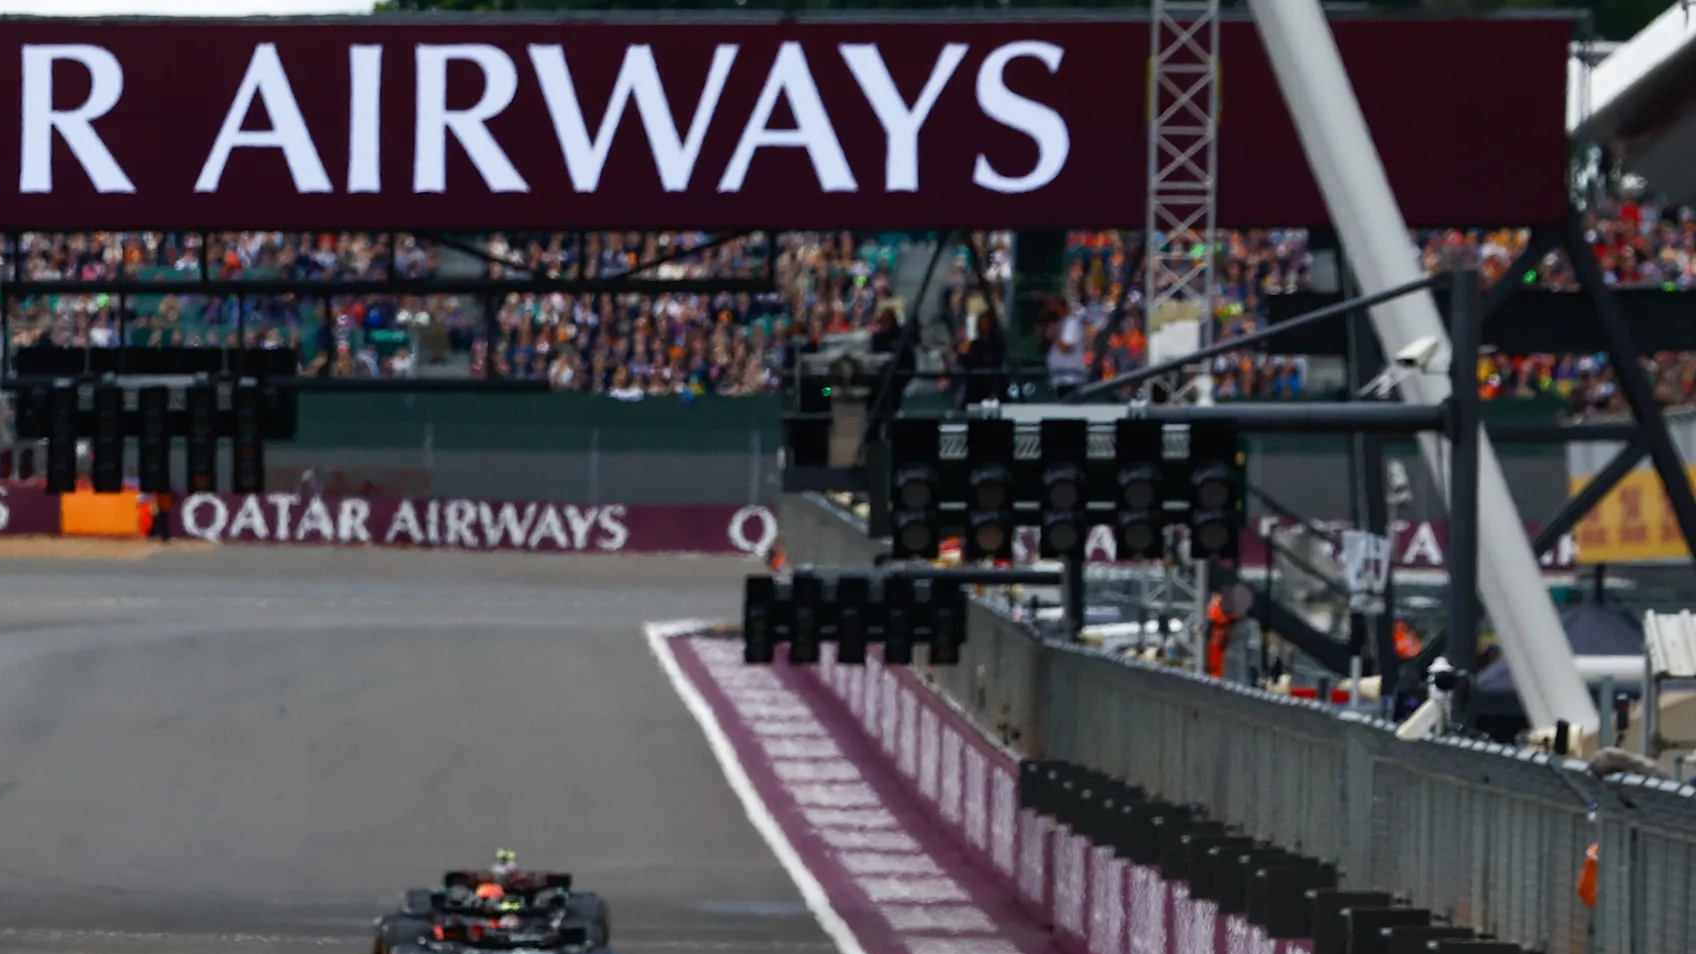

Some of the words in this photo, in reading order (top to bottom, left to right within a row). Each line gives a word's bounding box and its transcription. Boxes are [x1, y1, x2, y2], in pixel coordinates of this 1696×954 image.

[194, 40, 1072, 194] AIRWAYS
[180, 491, 371, 544] QATAR
[384, 499, 629, 552] AIRWAYS
